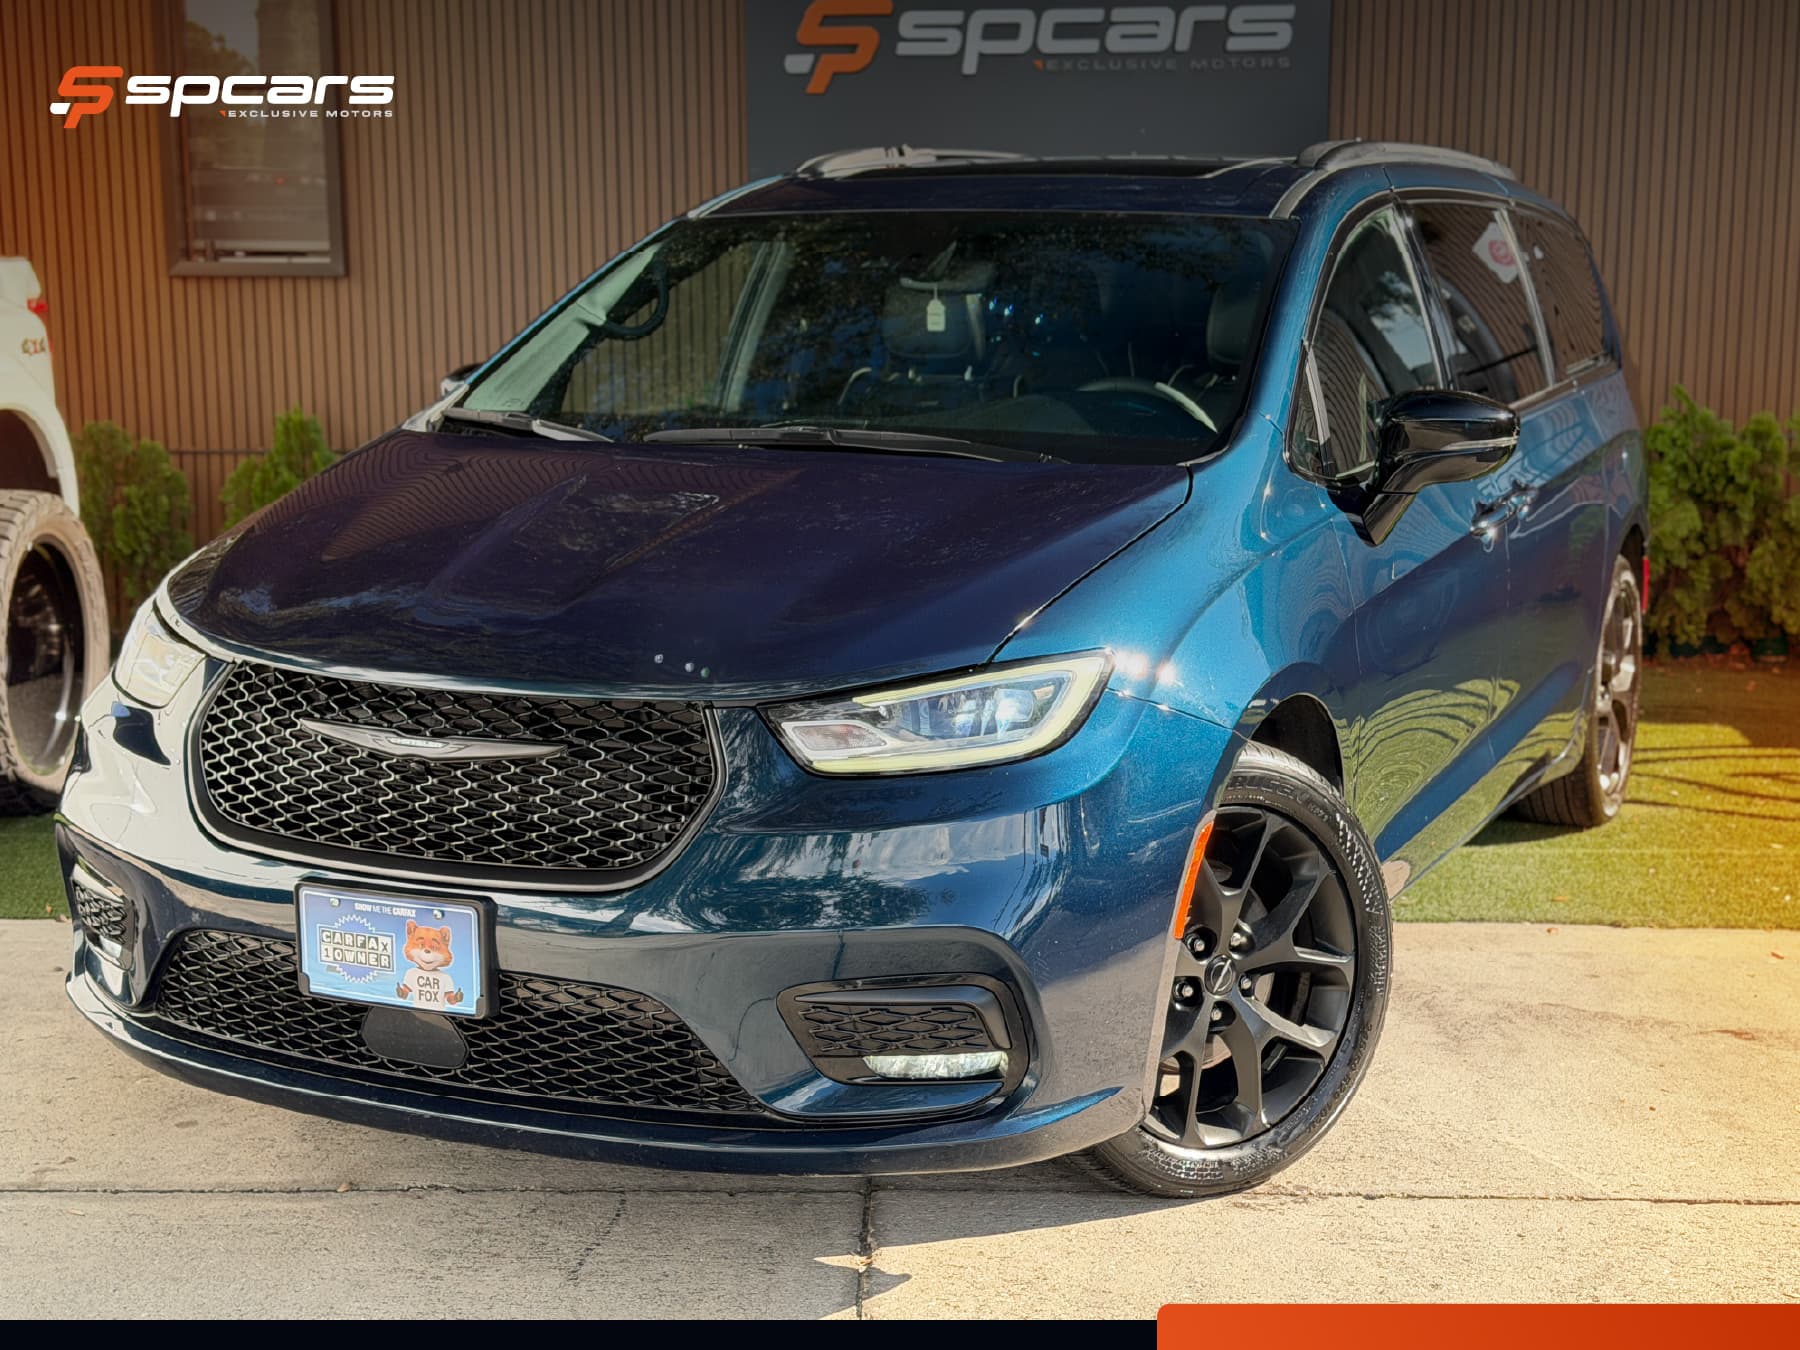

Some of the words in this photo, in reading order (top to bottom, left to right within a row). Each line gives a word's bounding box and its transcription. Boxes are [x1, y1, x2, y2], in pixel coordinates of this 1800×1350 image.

[896, 4, 1296, 75] spcars
[1045, 59, 1178, 72] EXCLUSIVE
[1190, 57, 1291, 70] MOTORS
[321, 930, 391, 953] CARFAX
[417, 976, 440, 991] CAR
[418, 989, 439, 1003] FOX
